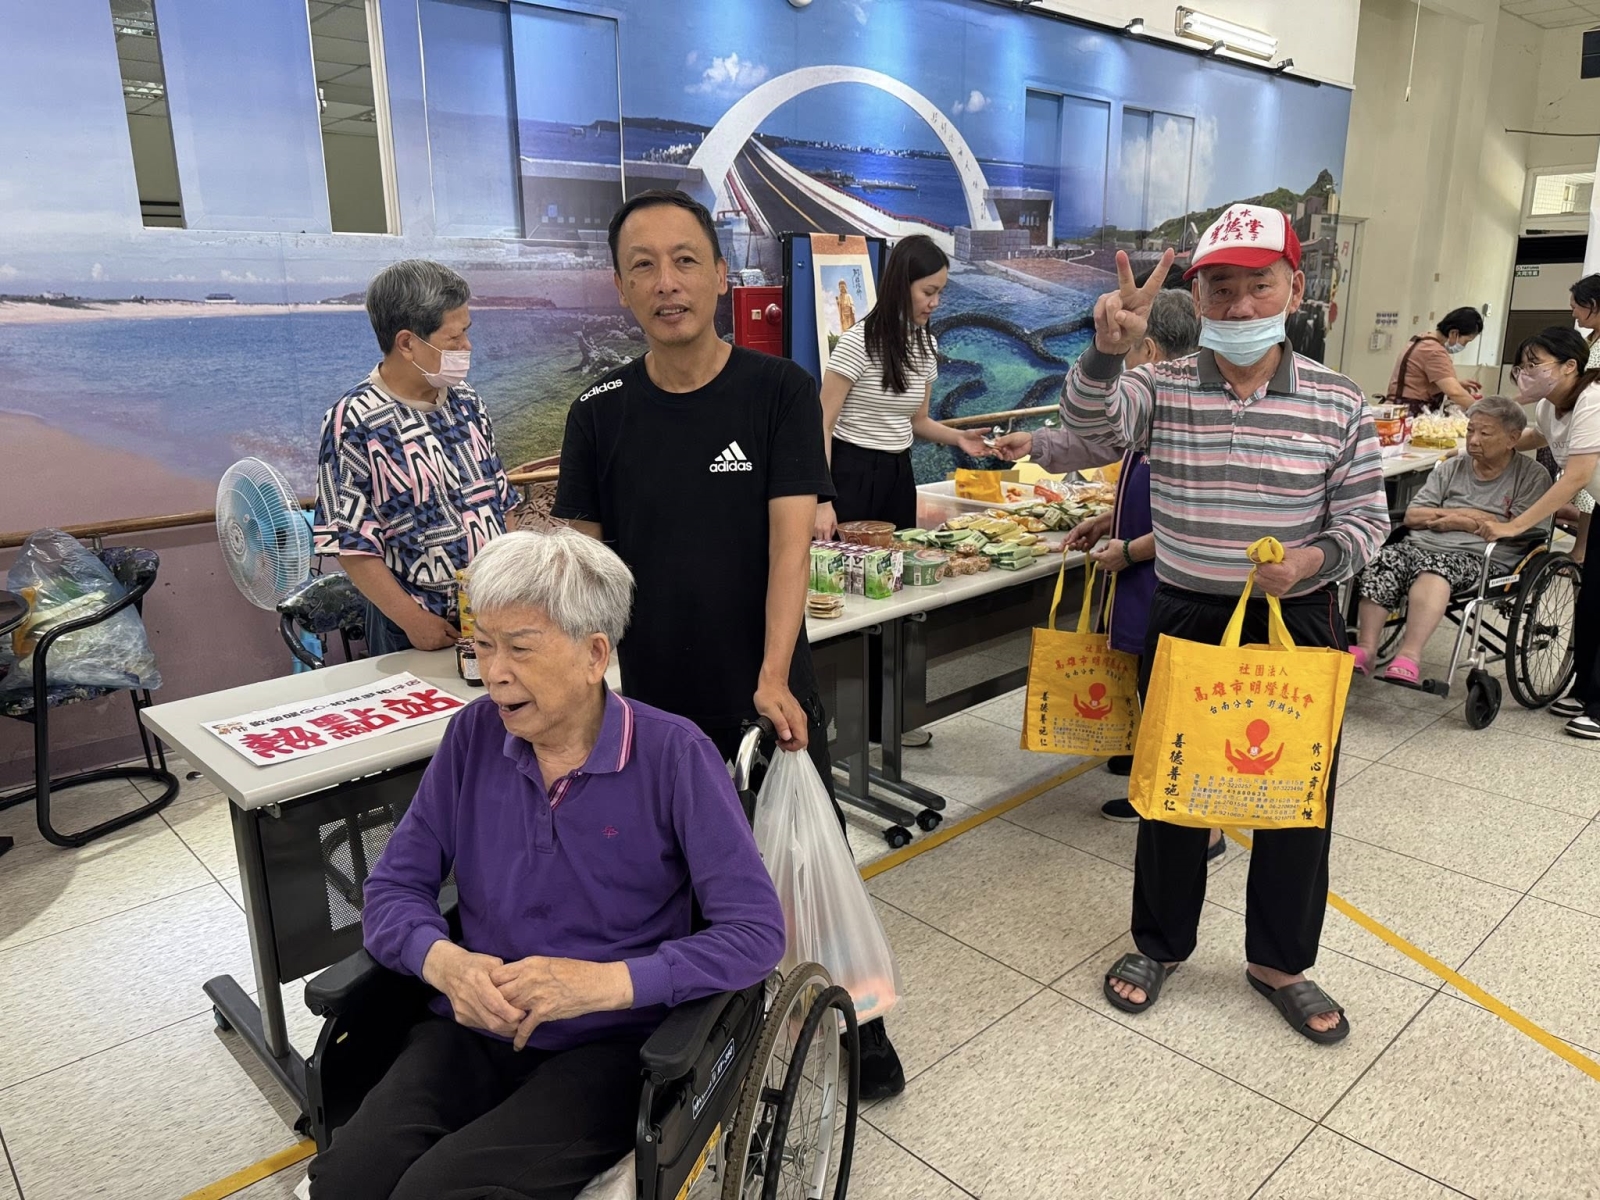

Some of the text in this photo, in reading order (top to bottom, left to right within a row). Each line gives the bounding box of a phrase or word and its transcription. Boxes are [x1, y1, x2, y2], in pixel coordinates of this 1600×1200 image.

[580, 378, 623, 402] adidas
[709, 460, 752, 472] adidas
[1239, 663, 1288, 677] 社團法人
[1210, 699, 1254, 715] 台南分會
[239, 689, 465, 758] 熱點站
[1164, 733, 1186, 811] 善德普施仁
